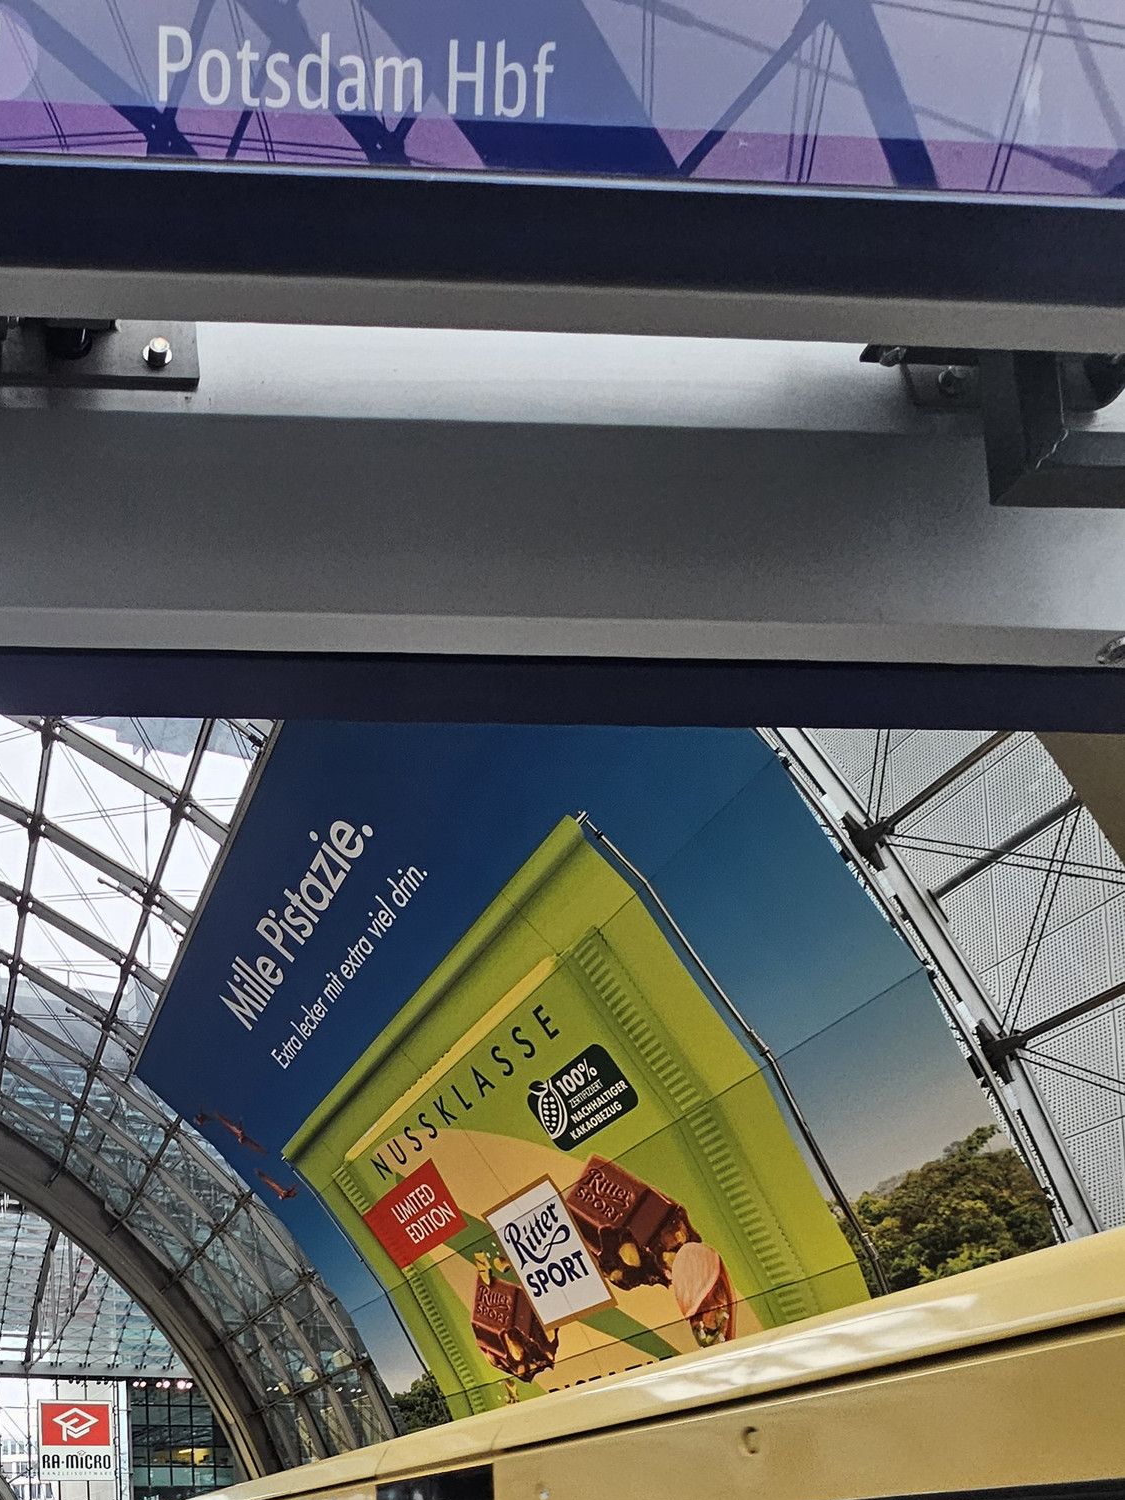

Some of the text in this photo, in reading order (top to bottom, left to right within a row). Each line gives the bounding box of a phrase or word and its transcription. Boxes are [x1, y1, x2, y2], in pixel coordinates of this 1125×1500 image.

[158, 25, 423, 114] Potsdam
[447, 38, 556, 118] Hbf
[219, 819, 374, 1031] Mille Pistazie.
[271, 865, 428, 1070] Extra lecker mit extra viel drin.
[370, 1004, 560, 1180] NUSSKLASSE
[556, 1058, 598, 1096] 100%
[569, 1101, 622, 1141] KAKAOBEZUG
[570, 1080, 628, 1123] NACHHALTIGER
[391, 1183, 435, 1225] LIMITED
[590, 1167, 635, 1208] Ritter
[405, 1203, 457, 1245] EDITION
[504, 1203, 571, 1270] Ritter
[526, 1250, 591, 1298] SPORT
